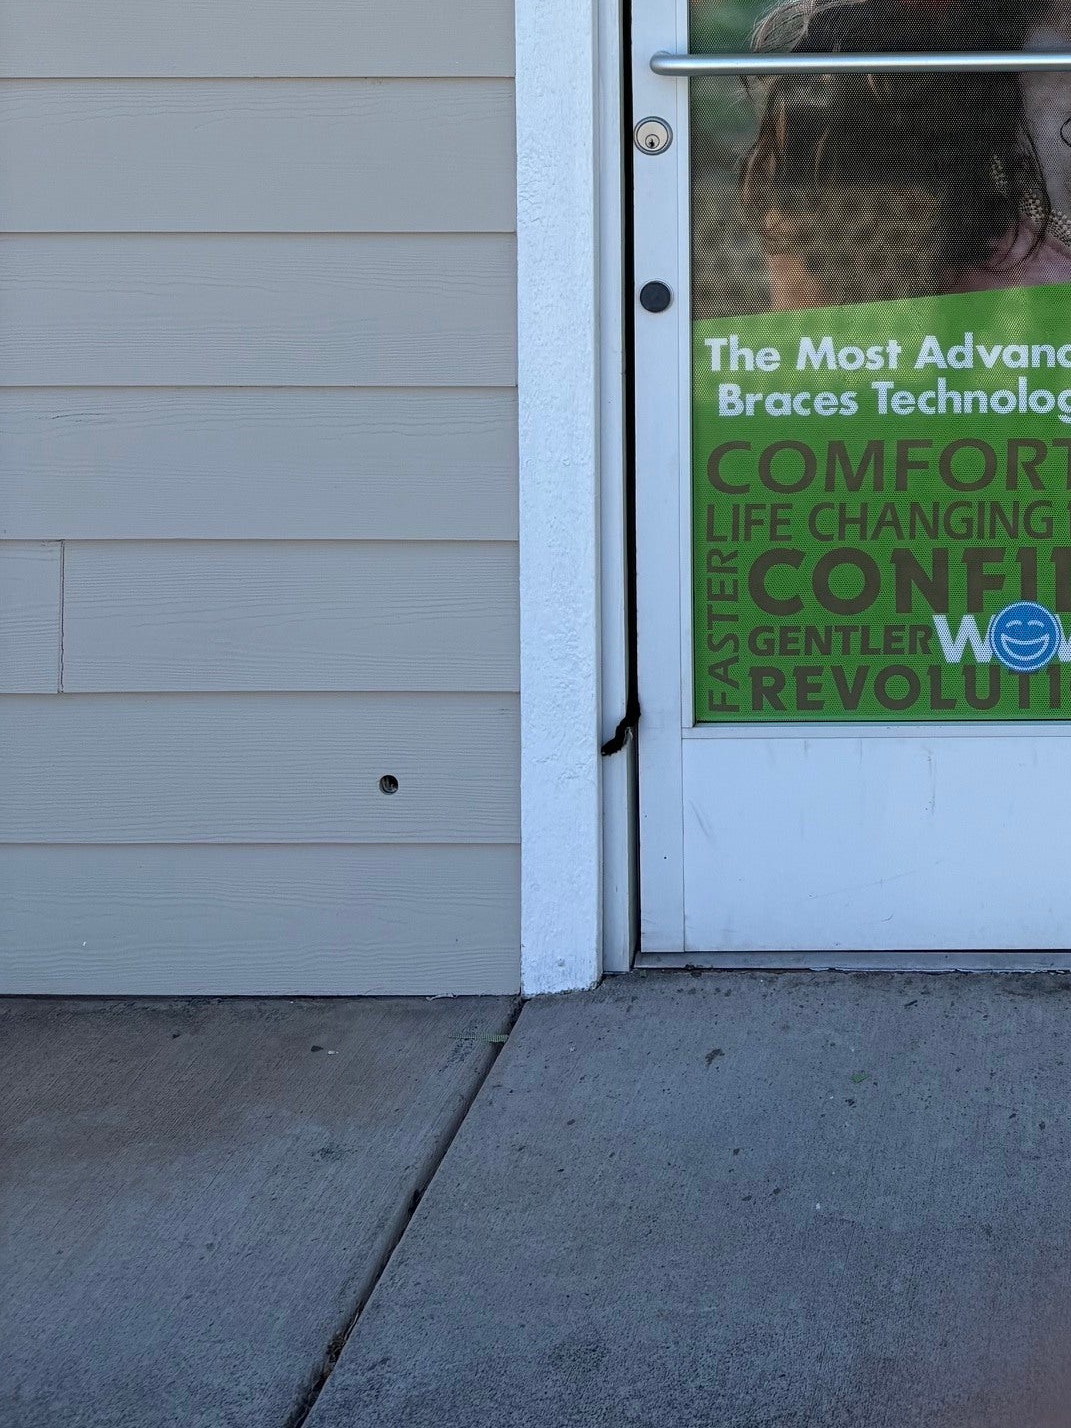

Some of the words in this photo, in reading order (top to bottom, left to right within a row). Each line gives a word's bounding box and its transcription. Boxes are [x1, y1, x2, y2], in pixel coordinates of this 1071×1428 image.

[704, 335, 780, 373] The
[796, 336, 902, 372] Most
[717, 383, 860, 417] Braces
[706, 502, 794, 542] LIFE
[807, 499, 1055, 541] CHANGING
[706, 549, 740, 713] FASTER
[747, 623, 932, 657] GENTLER
